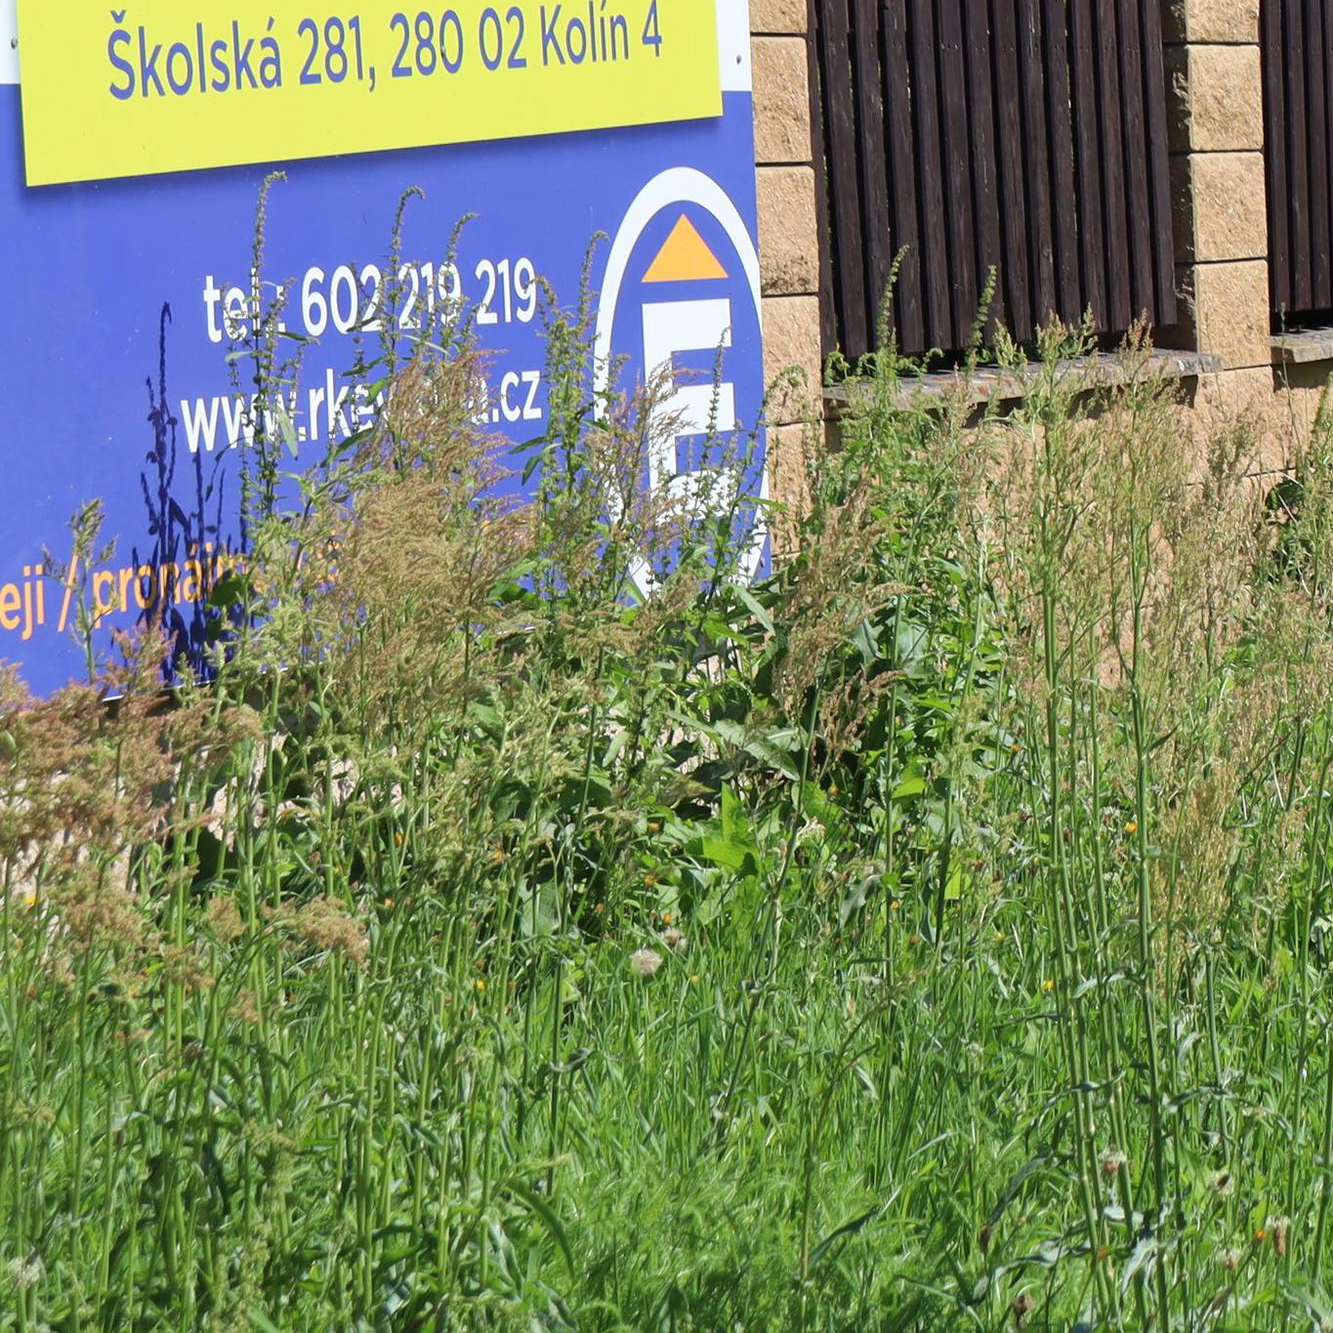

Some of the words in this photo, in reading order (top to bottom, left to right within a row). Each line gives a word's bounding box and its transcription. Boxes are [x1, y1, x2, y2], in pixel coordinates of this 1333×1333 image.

[107, 9, 283, 101] Školská
[299, 14, 376, 93] 281,
[390, 9, 464, 77] 280
[478, 5, 527, 70] 02
[302, 263, 383, 337] 602
[398, 260, 462, 329] 219
[475, 257, 537, 325] 219
